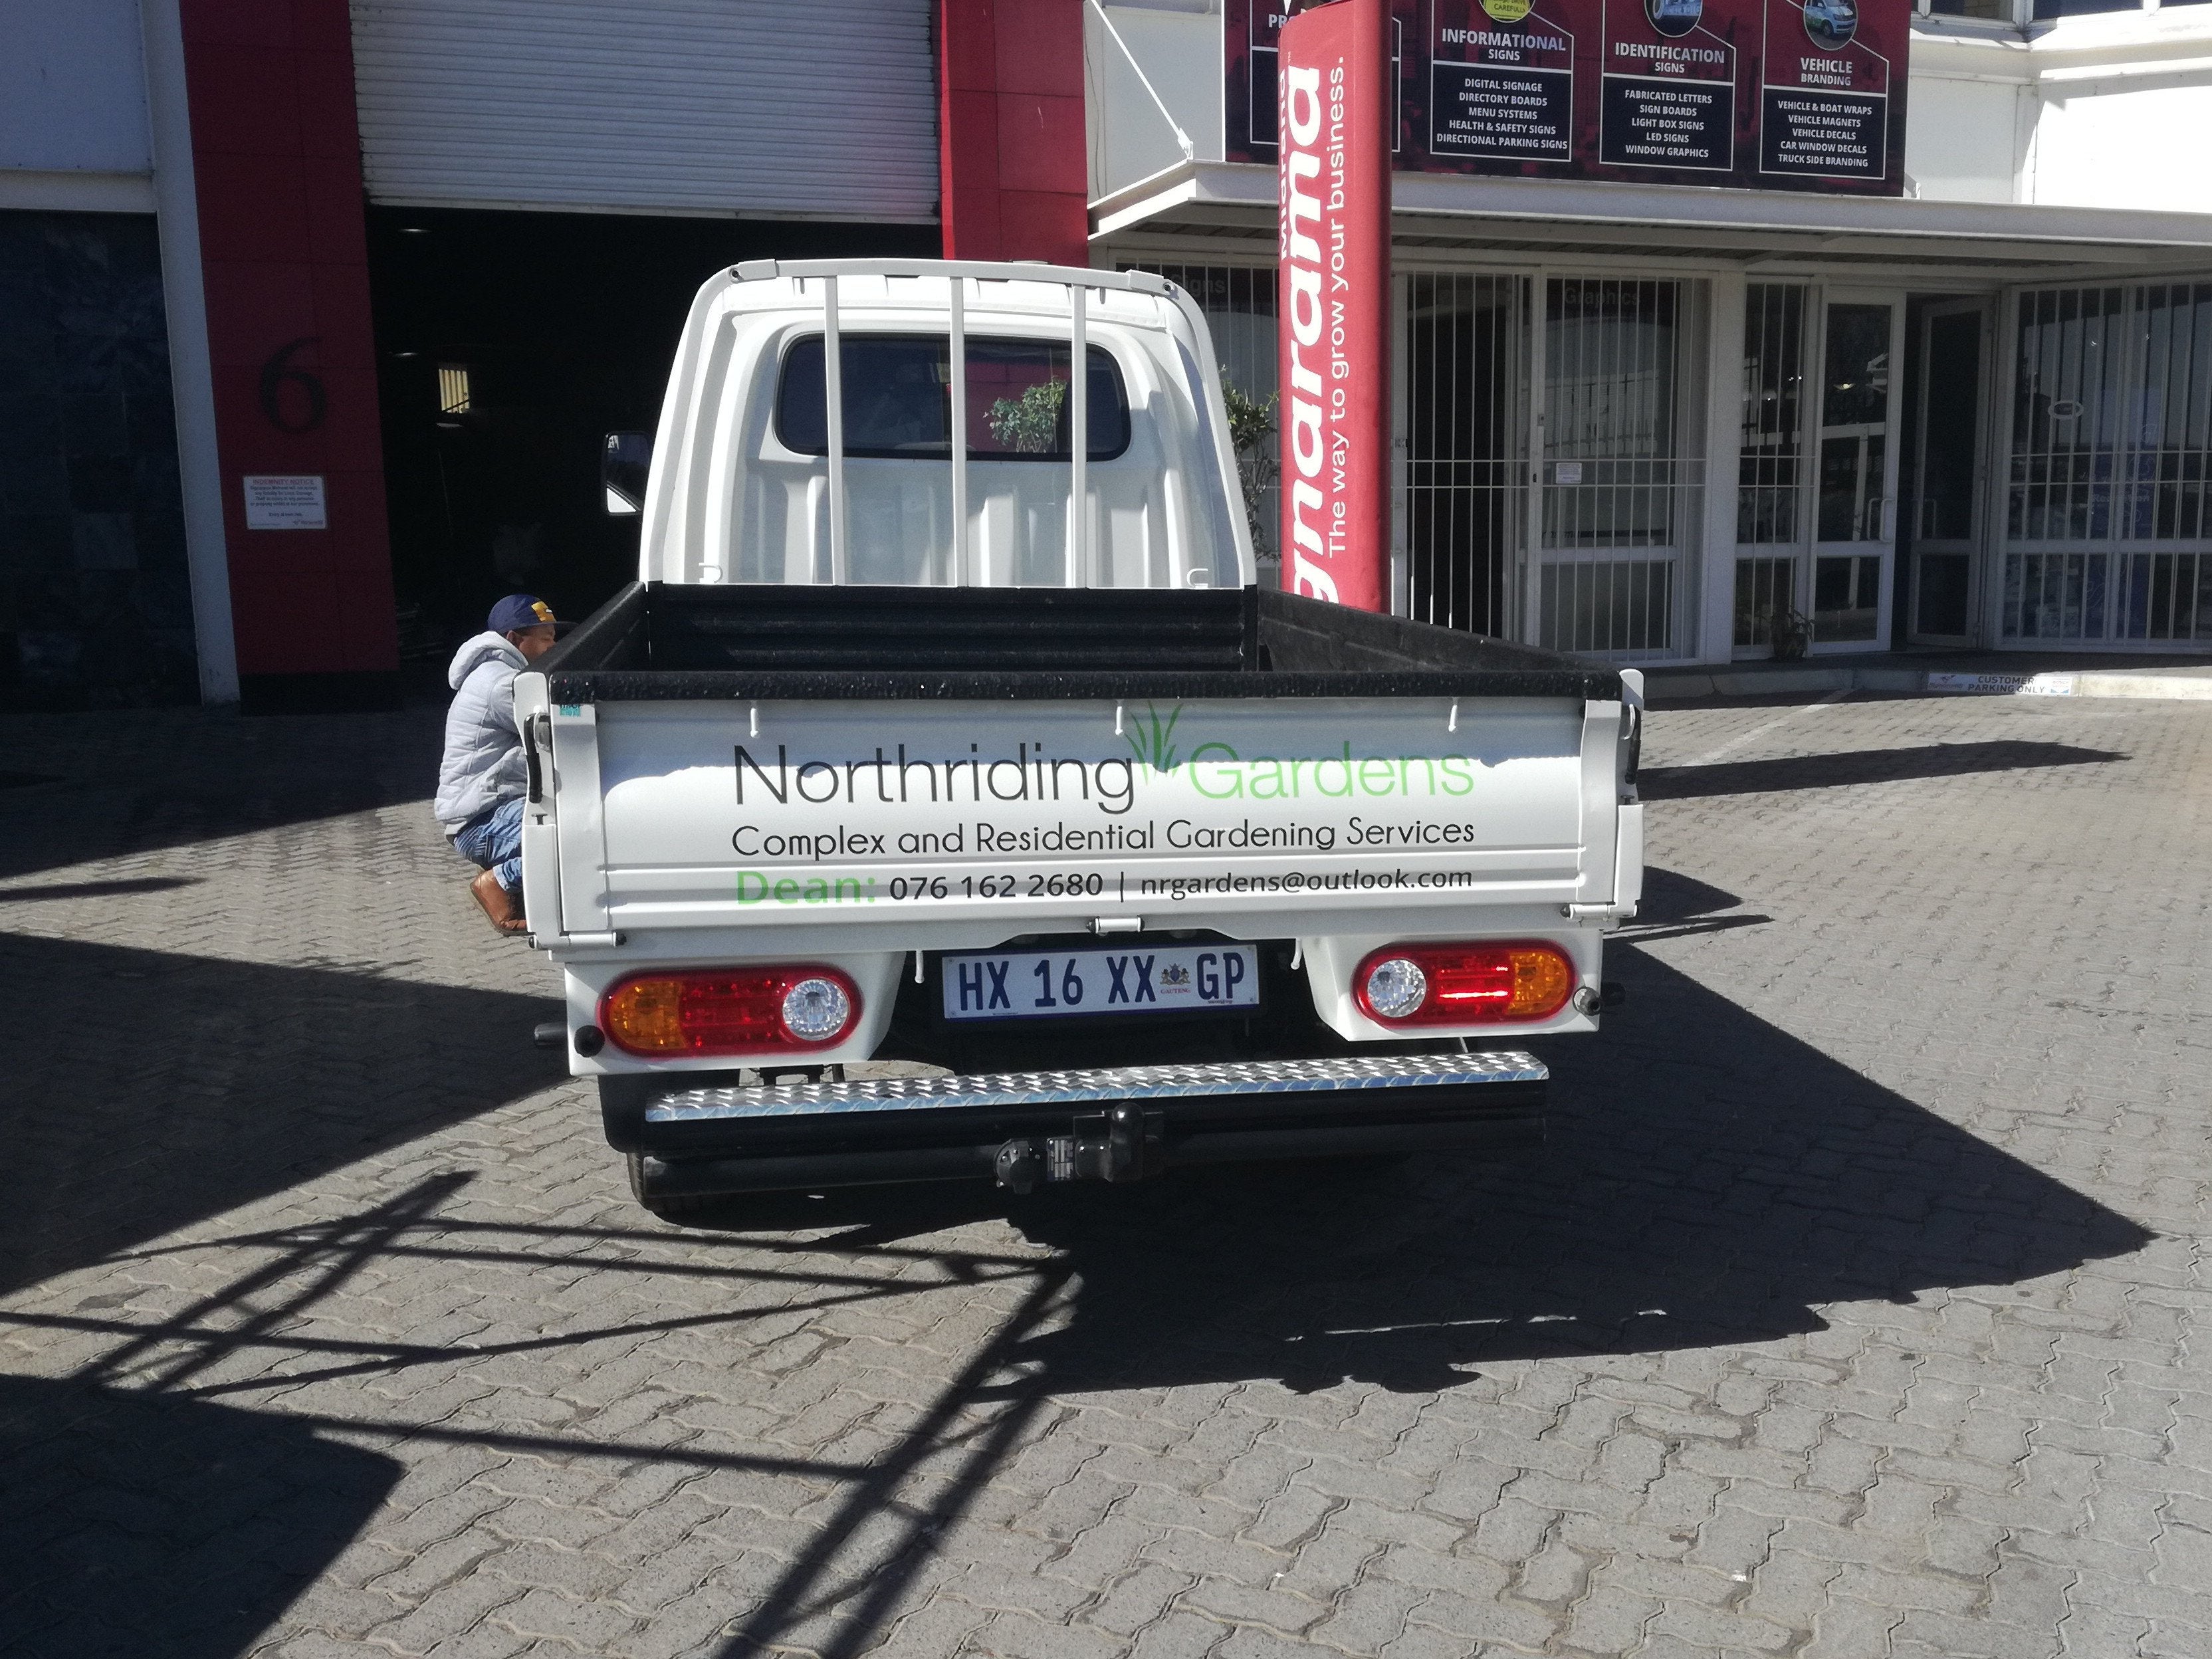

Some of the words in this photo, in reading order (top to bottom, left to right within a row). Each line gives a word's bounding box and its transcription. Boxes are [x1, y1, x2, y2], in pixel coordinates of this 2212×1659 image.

[1442, 29, 1566, 51] INFORMATIONAL
[1488, 49, 1520, 61] SIGNS
[1615, 43, 1725, 64] IDENTIFICATION
[1654, 61, 1685, 74] SIGNS
[1801, 57, 1852, 74] VEHICLE
[1465, 78, 1500, 90] DIGITAL
[1503, 79, 1543, 92] SIGNAGE
[1801, 73, 1851, 86] BRANDING
[1459, 92, 1508, 104] DIRECTORY
[1511, 94, 1548, 106] BOARDS
[1625, 90, 1676, 102] FABRICATED
[1678, 92, 1712, 104] LETTERS
[1468, 106, 1495, 118] MENU
[1497, 108, 1538, 120] SYSTEMS
[1640, 104, 1661, 115] SIGN
[1663, 106, 1697, 117] BOARDS
[1778, 100, 1811, 111] VEHICLE
[1812, 102, 1819, 112] &
[1820, 102, 1842, 112] BOAT
[1843, 104, 1872, 115] WRAPS
[1449, 119, 1485, 132] HEALTH
[1486, 121, 1493, 132] &
[1495, 122, 1528, 134] SAFETY
[1529, 123, 1556, 135] SIGNS
[1632, 117, 1658, 128] LIGHT
[1659, 119, 1677, 129] BOX
[1678, 119, 1704, 130] SIGNS
[1788, 114, 1821, 126] VEHICLE
[1822, 116, 1861, 127] MAGNETS
[1326, 56, 1345, 211] business.
[1646, 132, 1662, 142] LED
[1664, 132, 1690, 144] SIGNS
[1792, 128, 1825, 139] VEHICLE
[1826, 129, 1856, 140] DECALS
[1436, 133, 1497, 146] DIRECTIONAL
[1498, 136, 1539, 148] PARKING
[1541, 138, 1568, 150] SIGNS
[1780, 140, 1797, 150] CAR
[1799, 141, 1836, 152] WINDOW
[1837, 143, 1867, 154] DECALS
[1625, 144, 1665, 156] WINDOW
[1666, 146, 1709, 158] GRAPHICS
[1778, 154, 1805, 164] TRUCK
[1806, 154, 1825, 165] SIDE
[1826, 156, 1868, 167] BRANDING
[1331, 218, 1349, 292] your
[1564, 286, 1640, 308] Graphcs
[1331, 300, 1349, 380] grow
[260, 336, 326, 433] 6
[1330, 388, 1346, 423] to
[1331, 430, 1350, 493] way
[1329, 500, 1346, 558] The
[1977, 675, 2035, 685] CUSTOMER
[1967, 683, 2015, 693] PARKING
[2017, 685, 2045, 694] ONLY
[734, 742, 1134, 815] Northriding
[1189, 740, 1474, 800] Gardens
[732, 825, 886, 861] Complex
[898, 823, 963, 853] and
[976, 820, 1154, 852] Residential
[1166, 818, 1336, 850] Gardening
[1347, 816, 1475, 845] Services
[736, 871, 875, 905] Dean:
[889, 876, 948, 901] 076
[960, 874, 1016, 899] 162
[1028, 873, 1103, 898] 2680
[1140, 868, 1472, 901] nrgardens@outlook.com
[958, 960, 1010, 1011] HX
[1034, 958, 1083, 1008] 16
[1106, 954, 1157, 1004] XX
[1196, 952, 1245, 1000] GP
